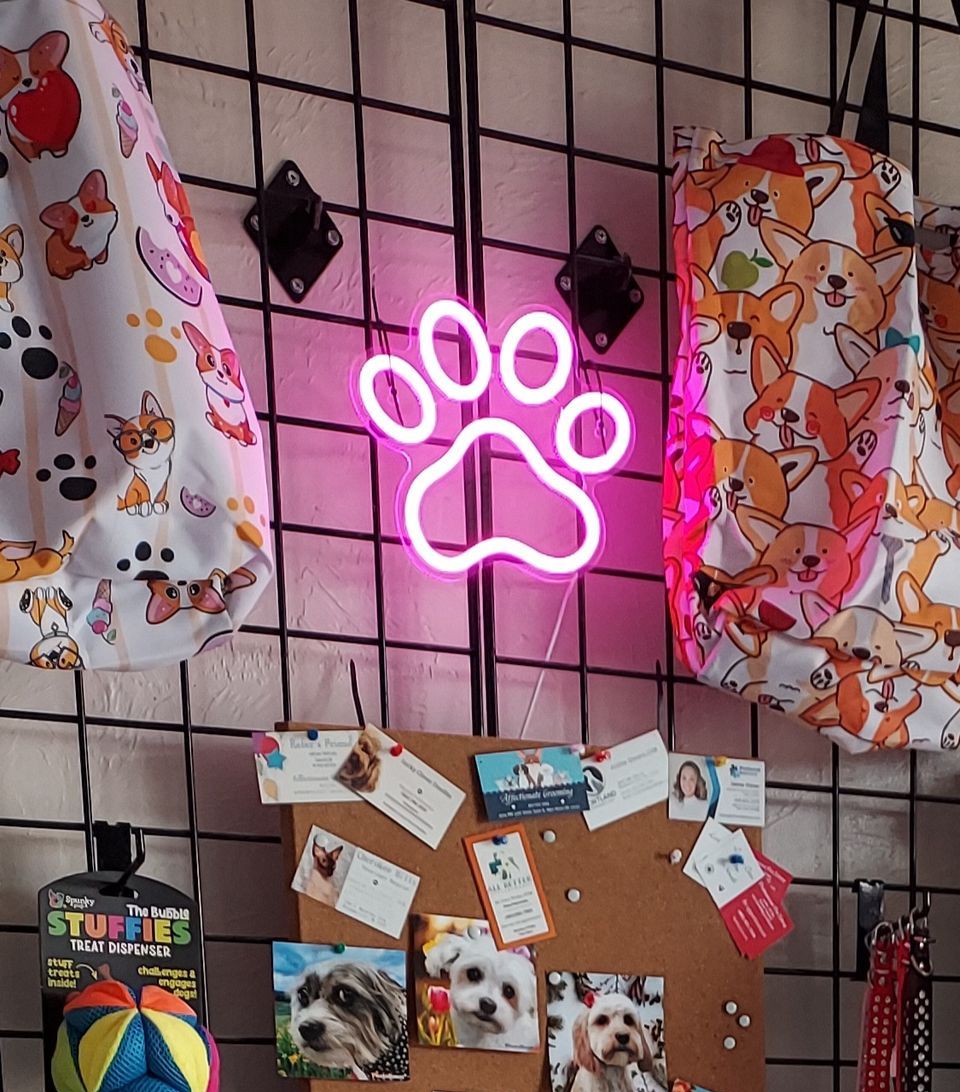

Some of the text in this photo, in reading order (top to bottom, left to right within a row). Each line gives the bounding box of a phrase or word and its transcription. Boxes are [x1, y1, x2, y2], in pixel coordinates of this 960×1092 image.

[65, 895, 95, 908] Spunky
[126, 904, 190, 920] The Bubble
[47, 911, 192, 945] STUFFIES
[70, 939, 172, 958] TREAT DISPENSER
[47, 958, 74, 967] stuff
[48, 968, 80, 978] treats
[137, 965, 187, 979] challenges
[47, 979, 77, 989] inside!
[158, 979, 196, 989] engages
